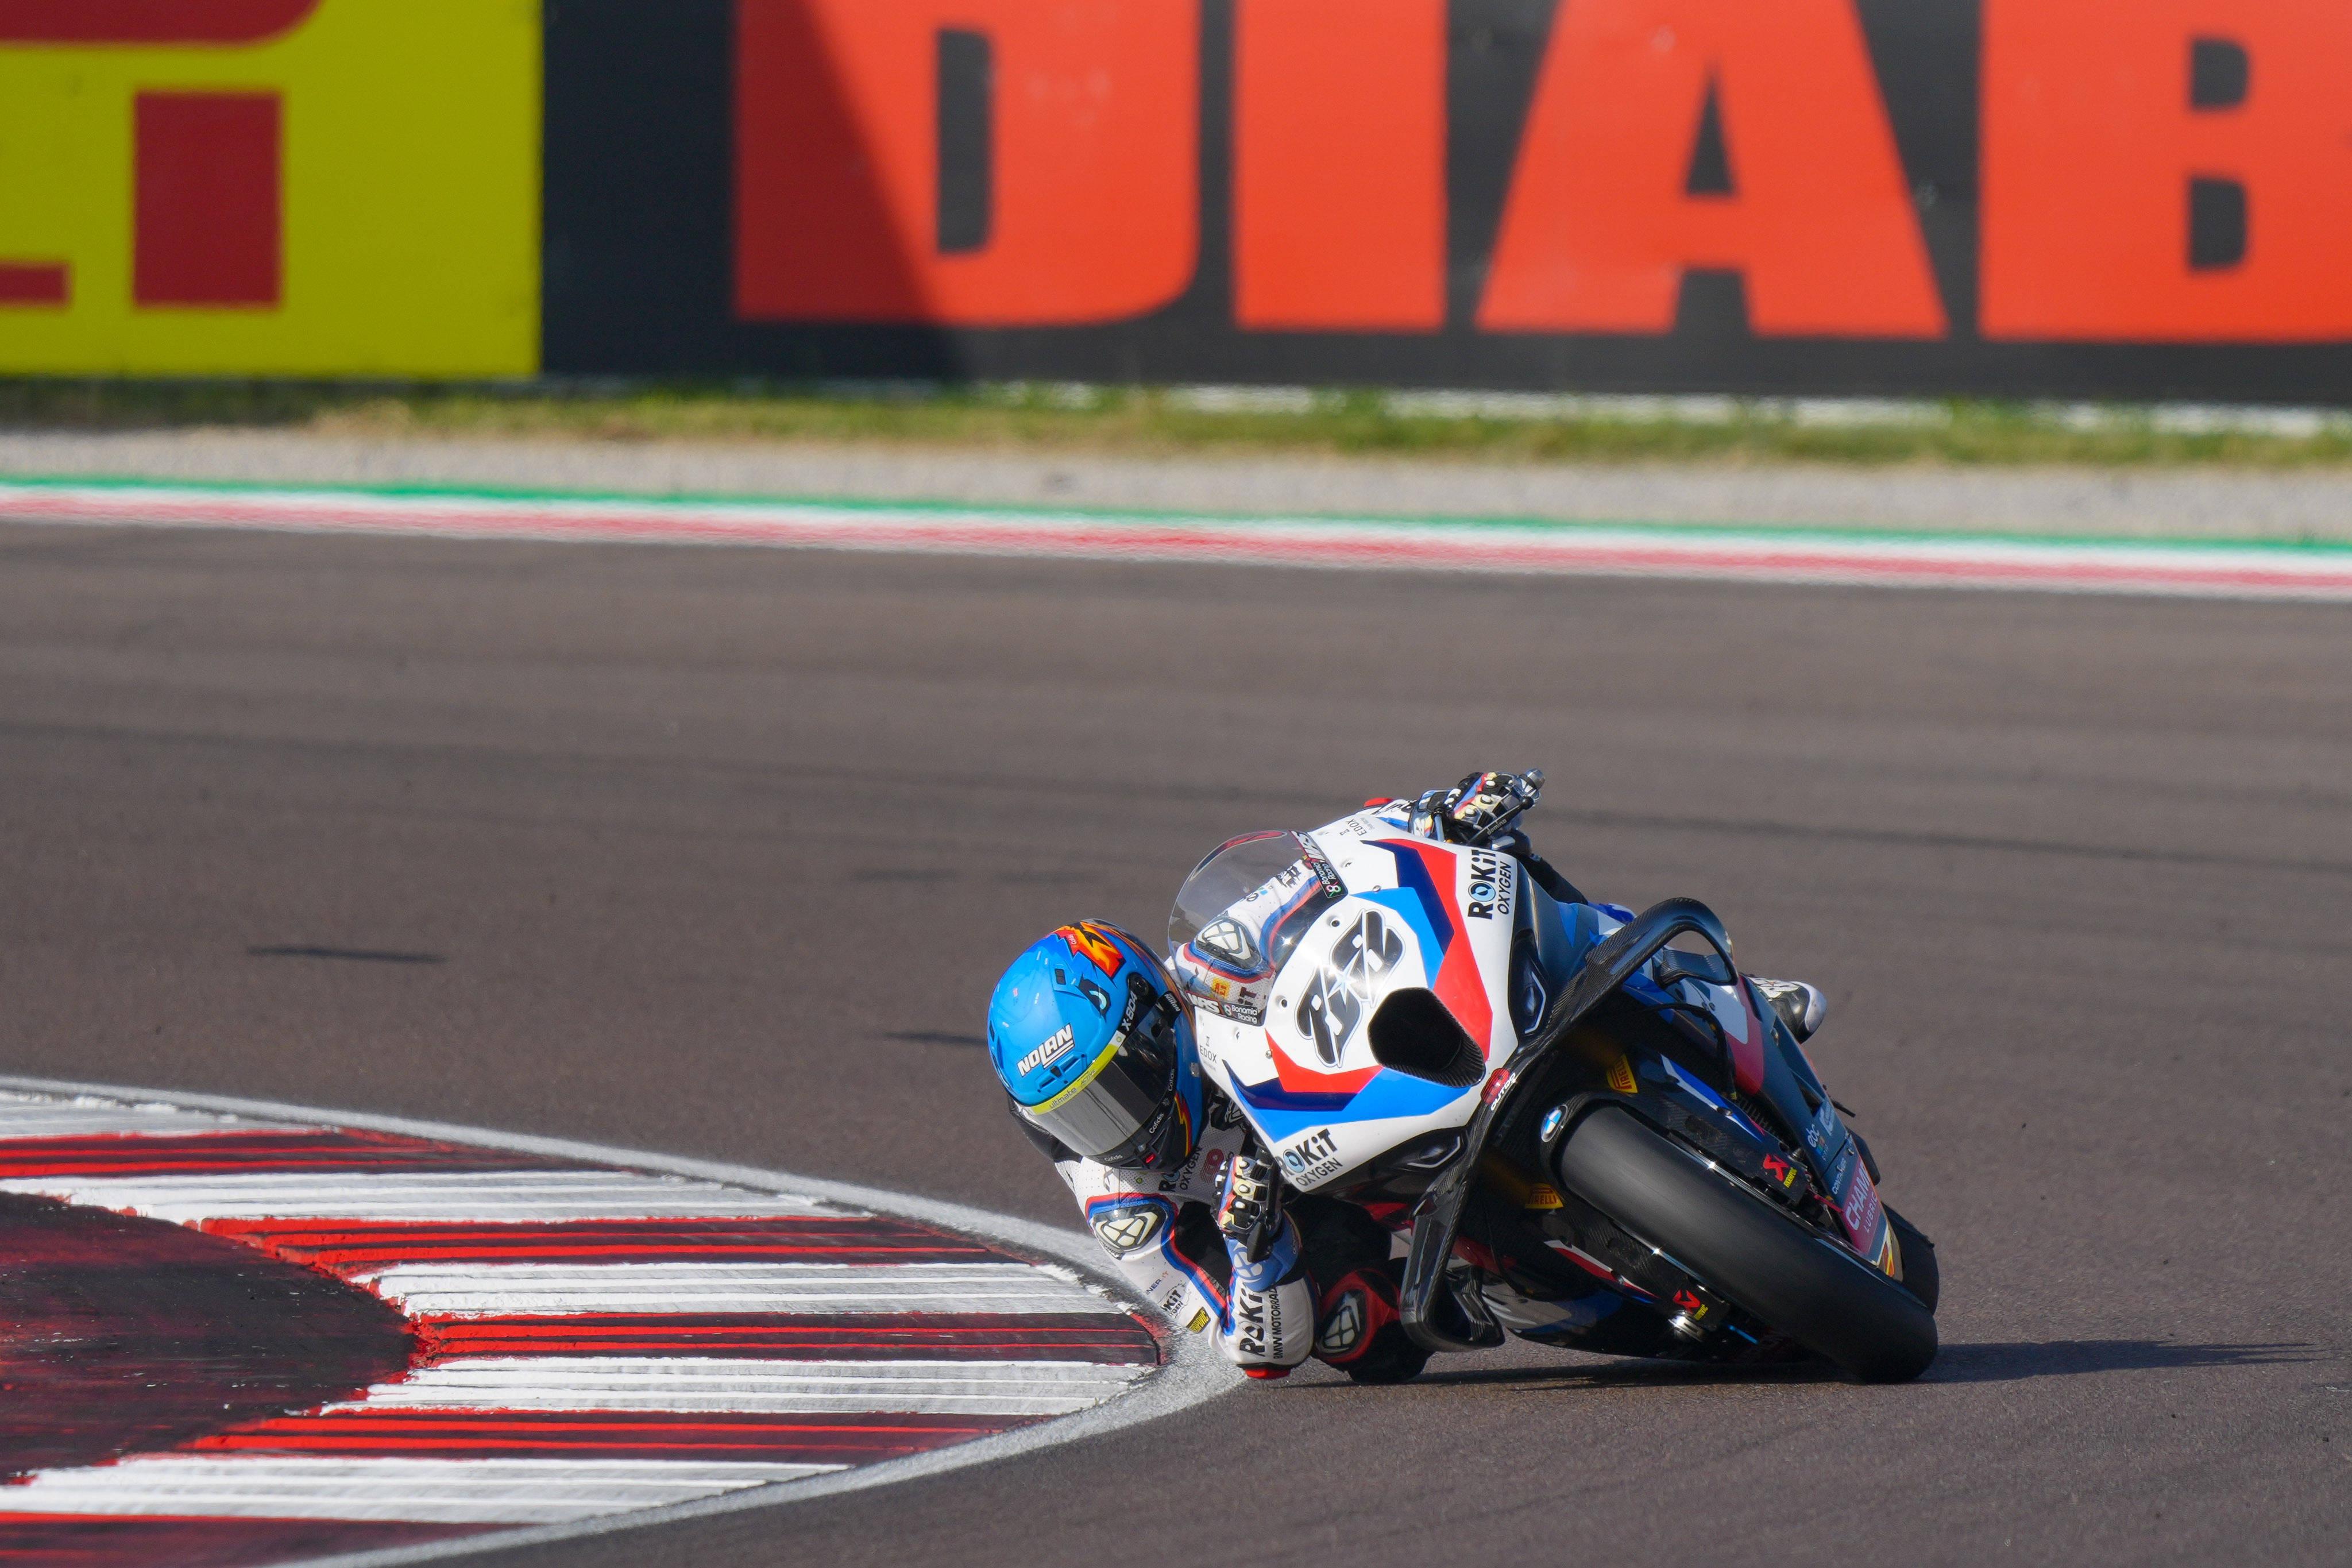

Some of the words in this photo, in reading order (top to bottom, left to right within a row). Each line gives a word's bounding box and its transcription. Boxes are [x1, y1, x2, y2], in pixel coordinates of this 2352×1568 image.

[1345, 818, 1368, 836] EDOX
[1486, 818, 1507, 835] domino
[1497, 860, 1512, 915] OXYGEN
[1231, 1005, 1258, 1016] Bonamici
[1237, 1013, 1257, 1024] Racing
[1017, 1023, 1075, 1077] NOLAN
[1199, 1045, 1217, 1063] EDOX
[1149, 1113, 1164, 1134] Cofidis
[1806, 1123, 1820, 1148] ebc
[1275, 1128, 1337, 1177] ROKiT
[1295, 1157, 1343, 1186] OXYGEN
[1239, 1282, 1265, 1357] ROKi
[1272, 1338, 1283, 1359] BMW
